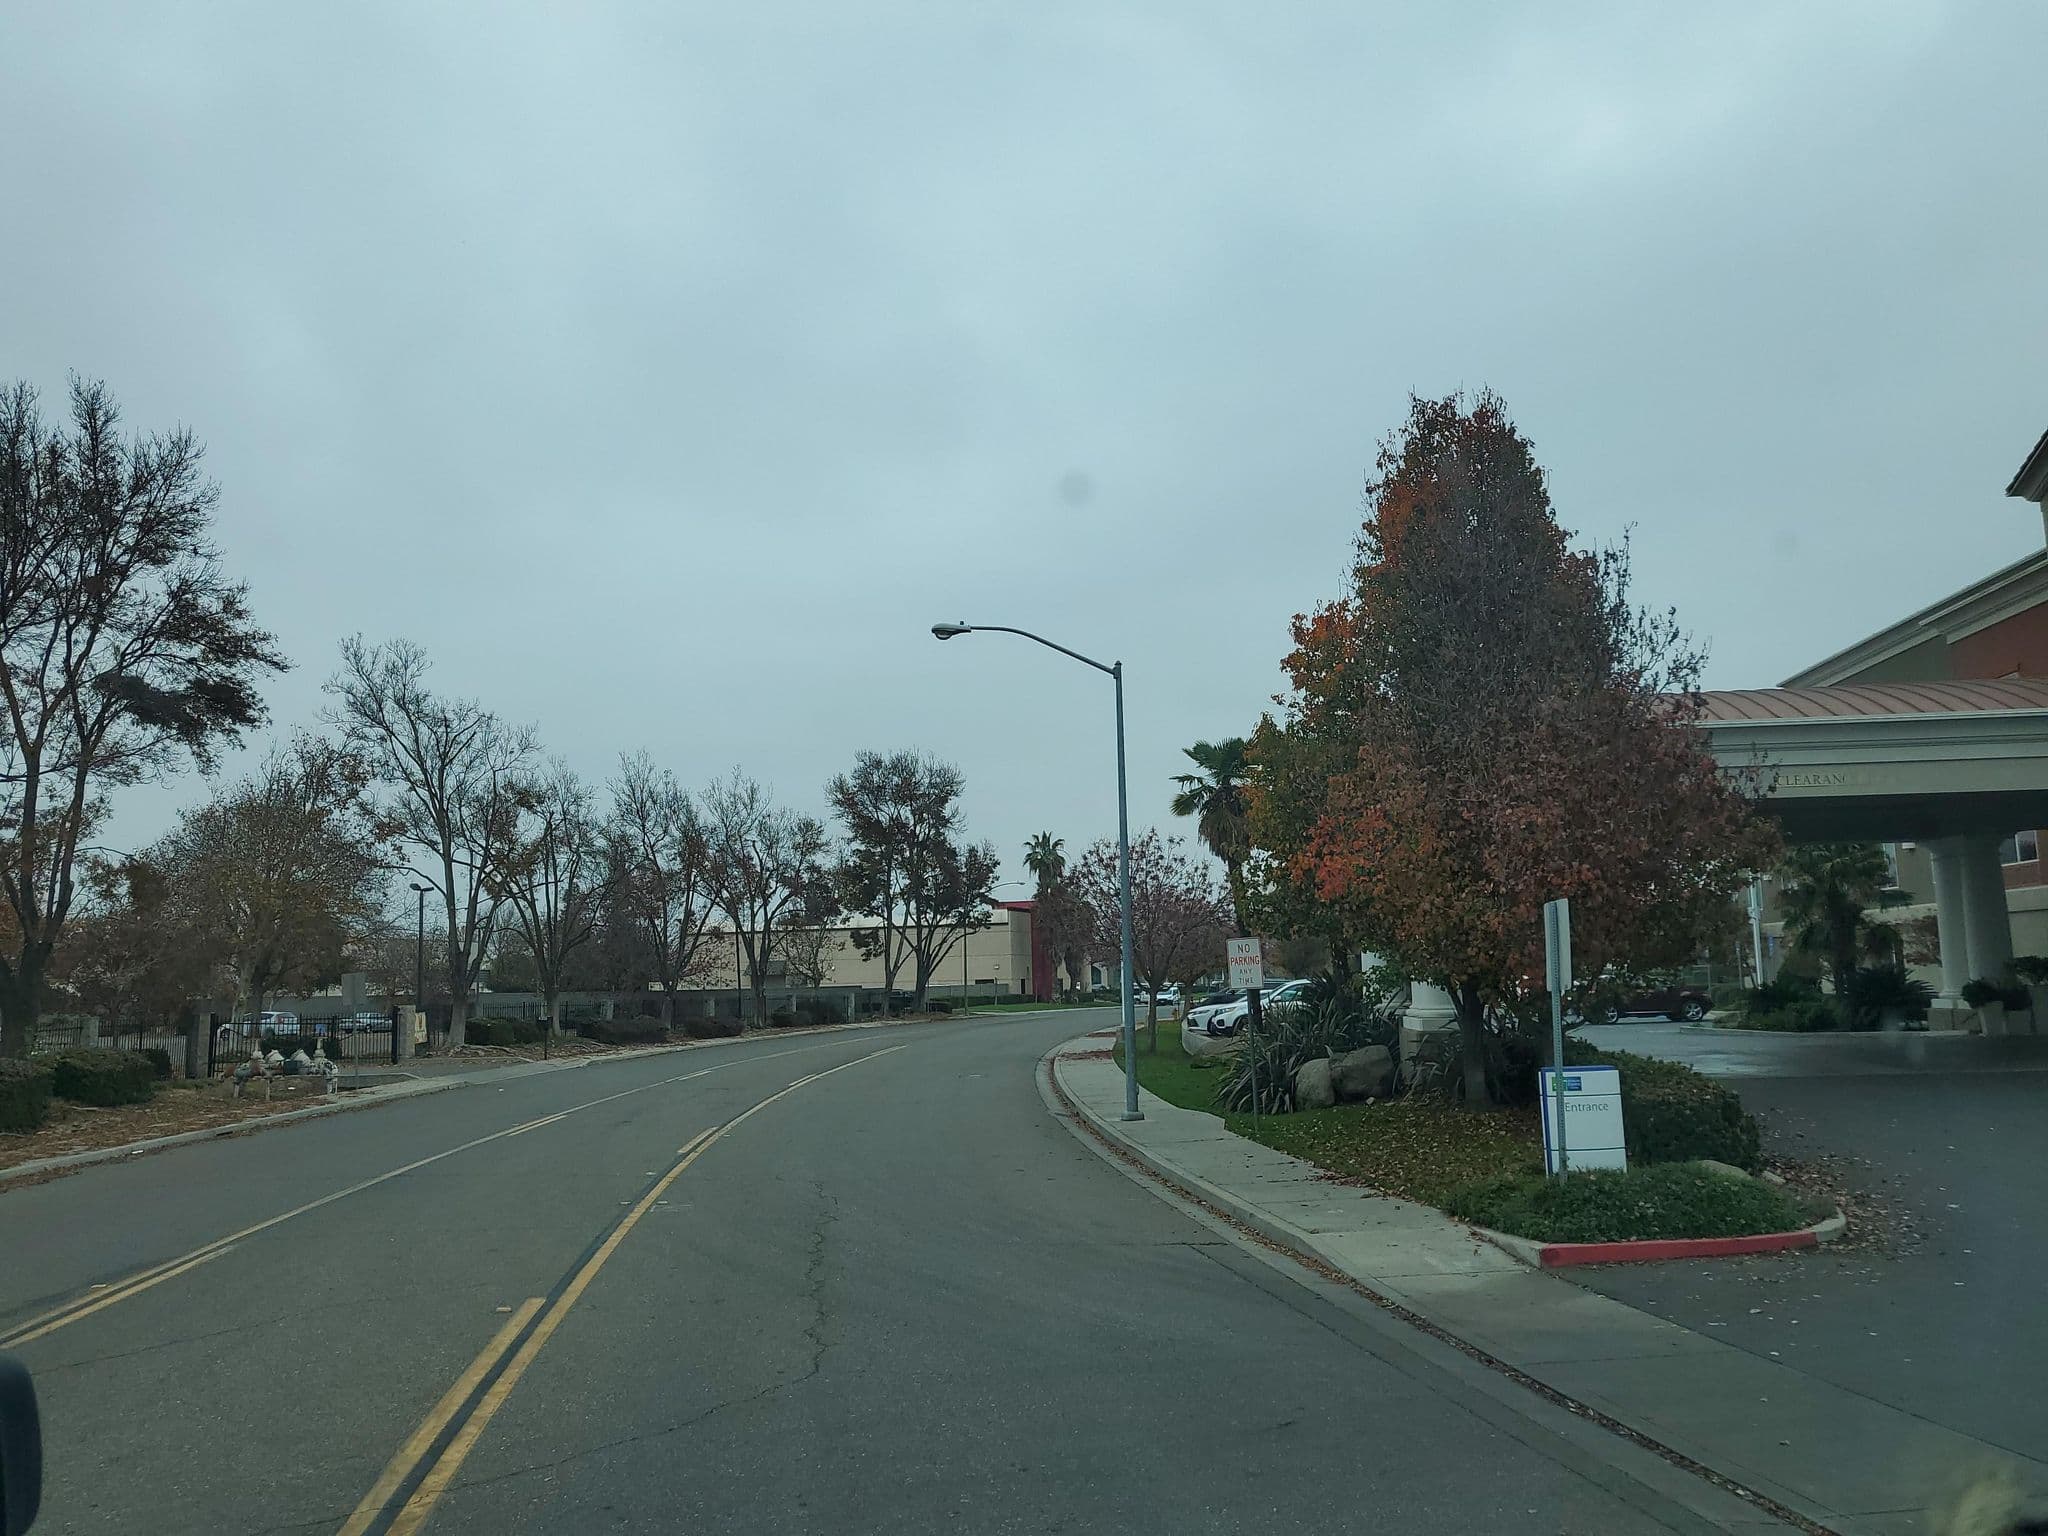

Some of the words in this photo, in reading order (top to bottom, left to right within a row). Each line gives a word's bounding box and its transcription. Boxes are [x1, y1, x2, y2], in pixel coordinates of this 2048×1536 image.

[1237, 944, 1250, 953] NO
[1231, 956, 1259, 966] PARKING
[1239, 977, 1254, 985] TIME
[1565, 1102, 1608, 1112] Entrance
